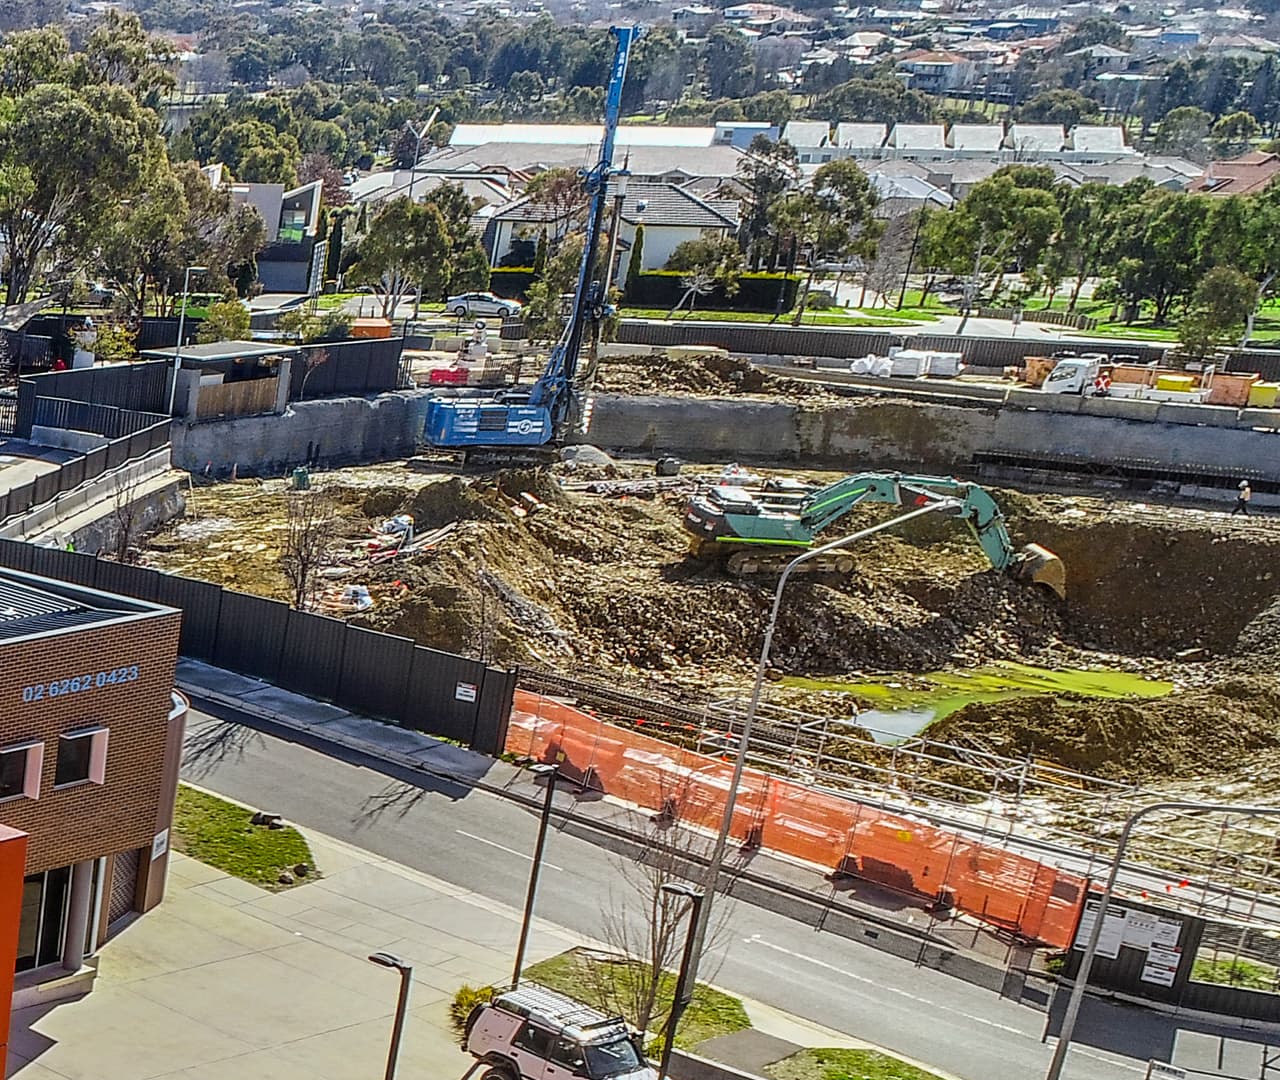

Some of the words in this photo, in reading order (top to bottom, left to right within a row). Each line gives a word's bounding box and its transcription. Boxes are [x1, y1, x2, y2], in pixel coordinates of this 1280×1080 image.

[23, 684, 44, 702] 02
[49, 675, 92, 697] 6262
[96, 665, 138, 688] 0423
